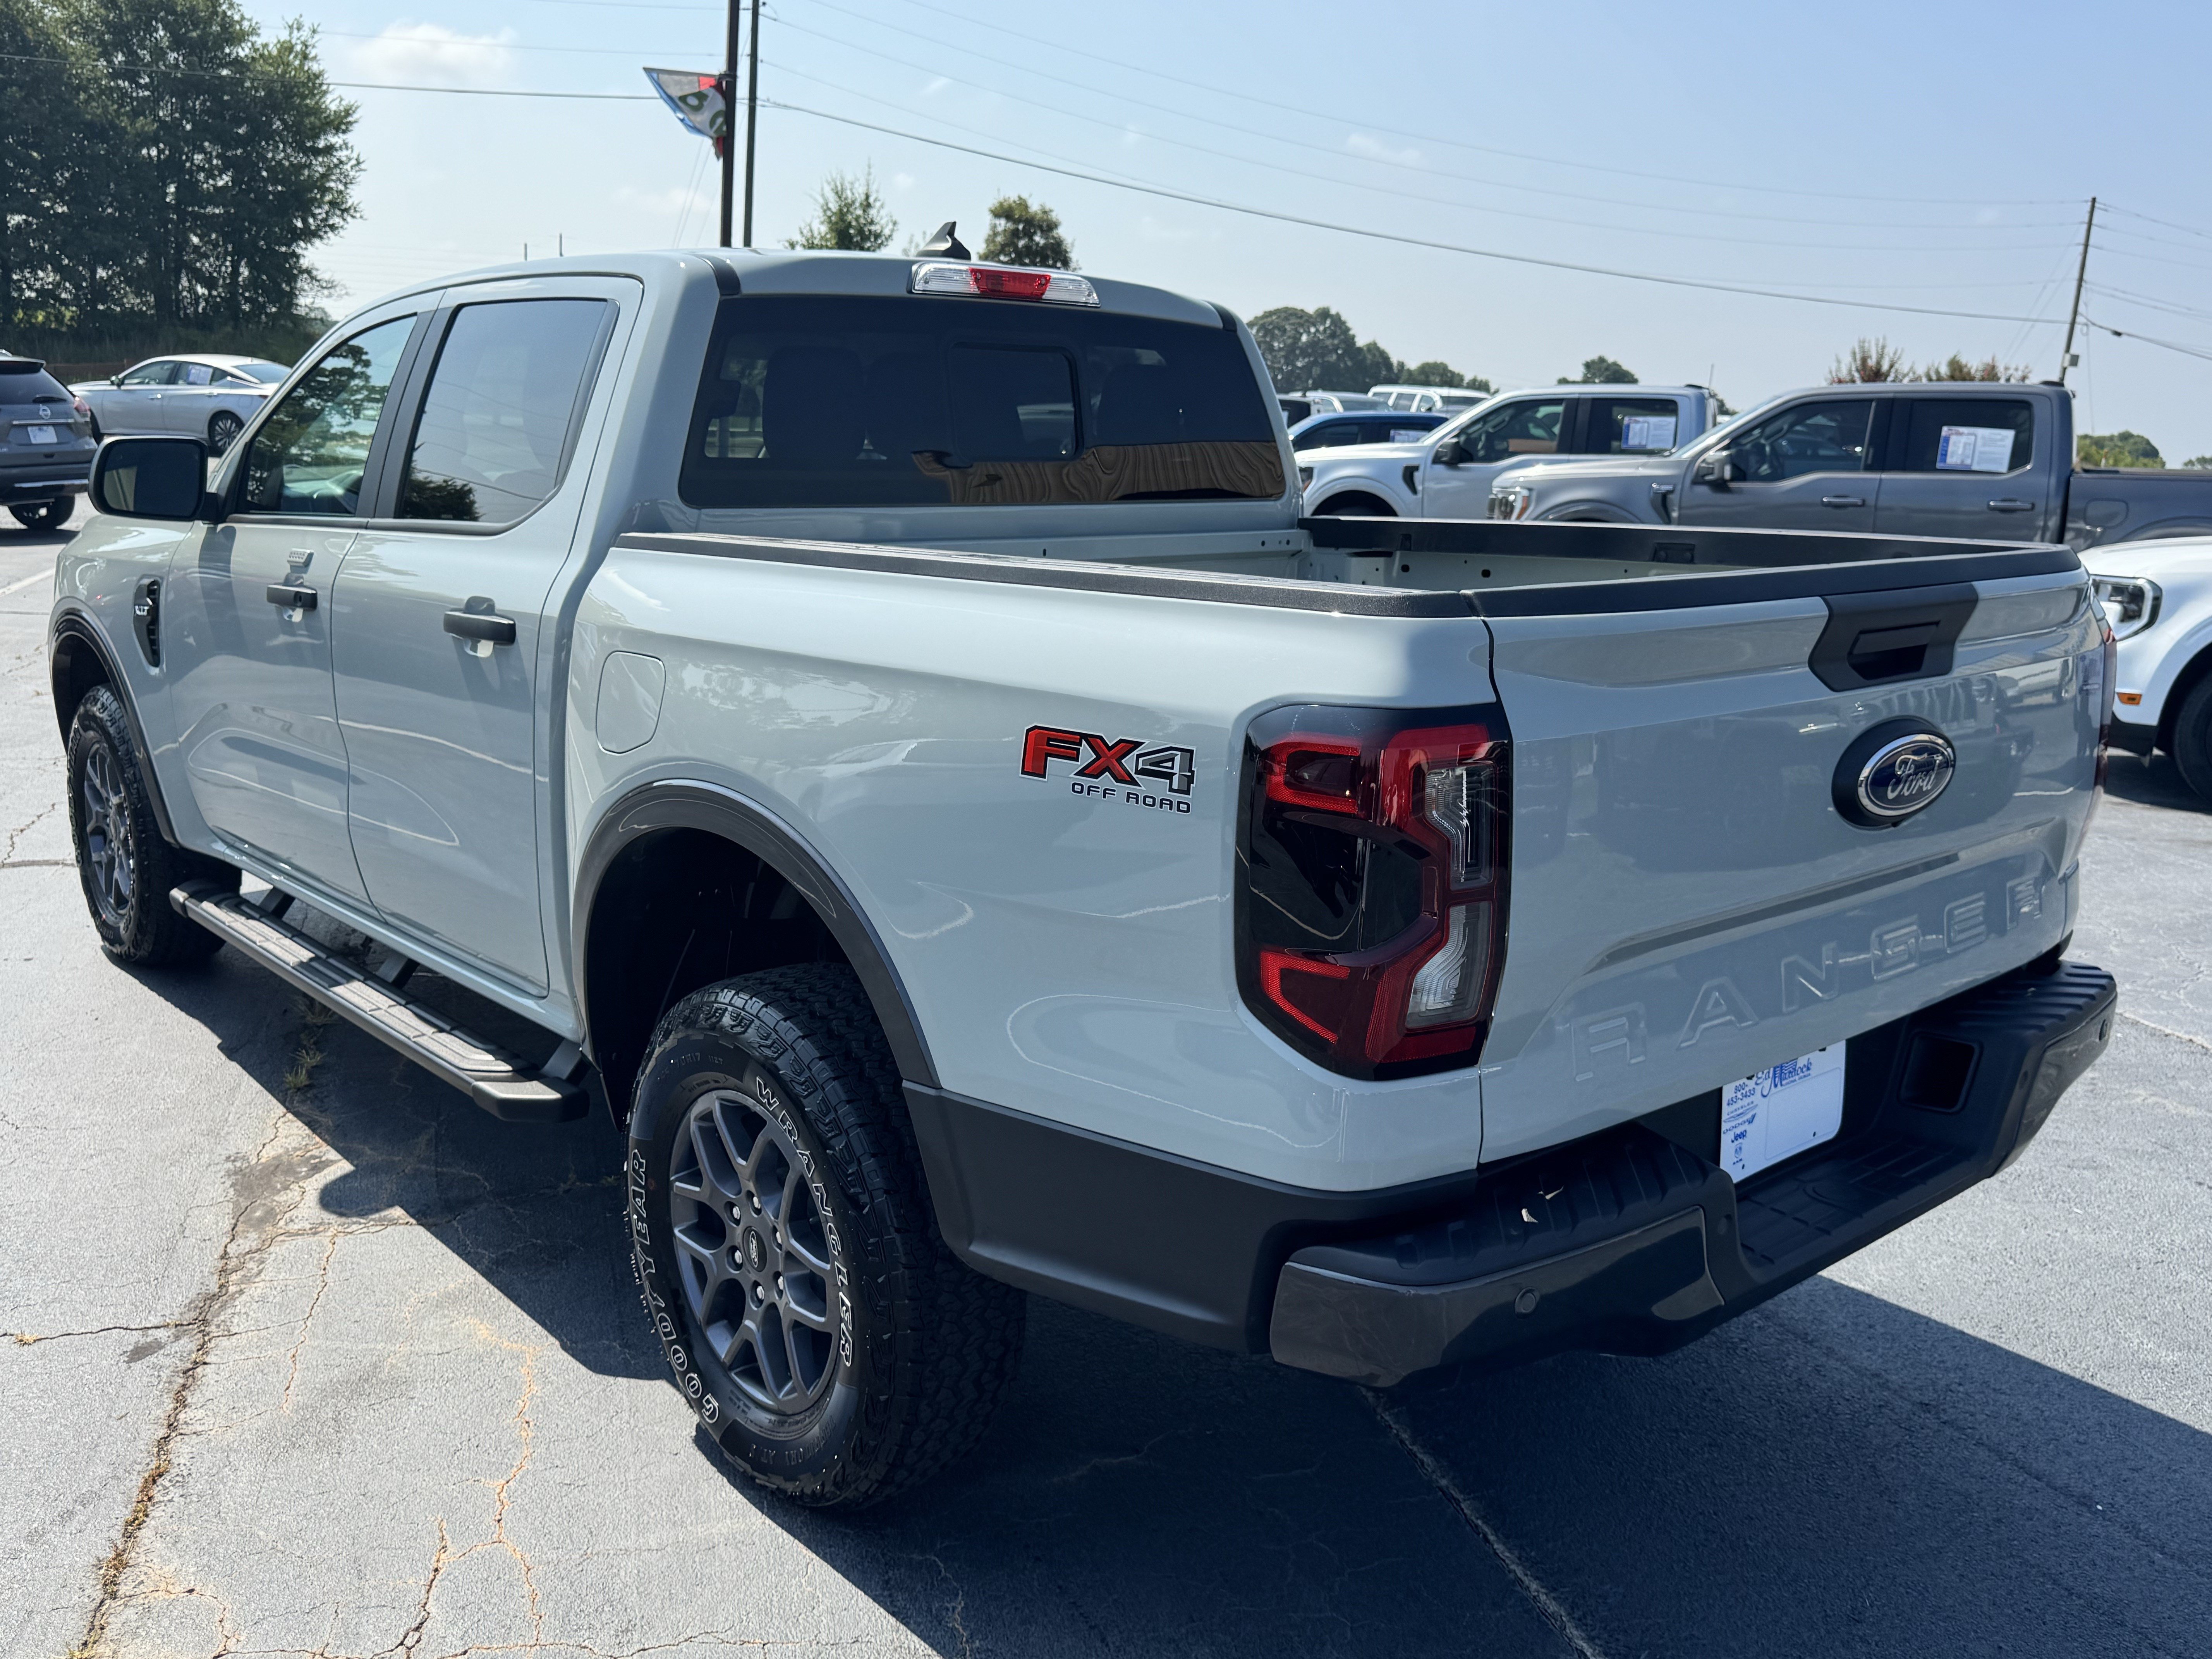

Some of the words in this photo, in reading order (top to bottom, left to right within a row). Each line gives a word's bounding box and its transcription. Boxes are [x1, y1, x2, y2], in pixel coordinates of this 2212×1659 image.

[1020, 723, 1196, 797] FX4
[1887, 752, 1942, 800] Ford
[1071, 781, 1116, 800] OFF
[1125, 791, 1191, 814] ROAD
[1570, 874, 2044, 1082] RANGER
[1734, 1082, 1748, 1094] 800-
[1755, 1069, 1770, 1085] Ed
[1726, 1087, 1755, 1106] 453-3433
[1727, 1101, 1754, 1116] CHRYSLER
[1731, 1129, 1747, 1143] Jeep
[756, 1077, 852, 1367] WRANGLER
[630, 1149, 719, 1423] GOODYEAR
